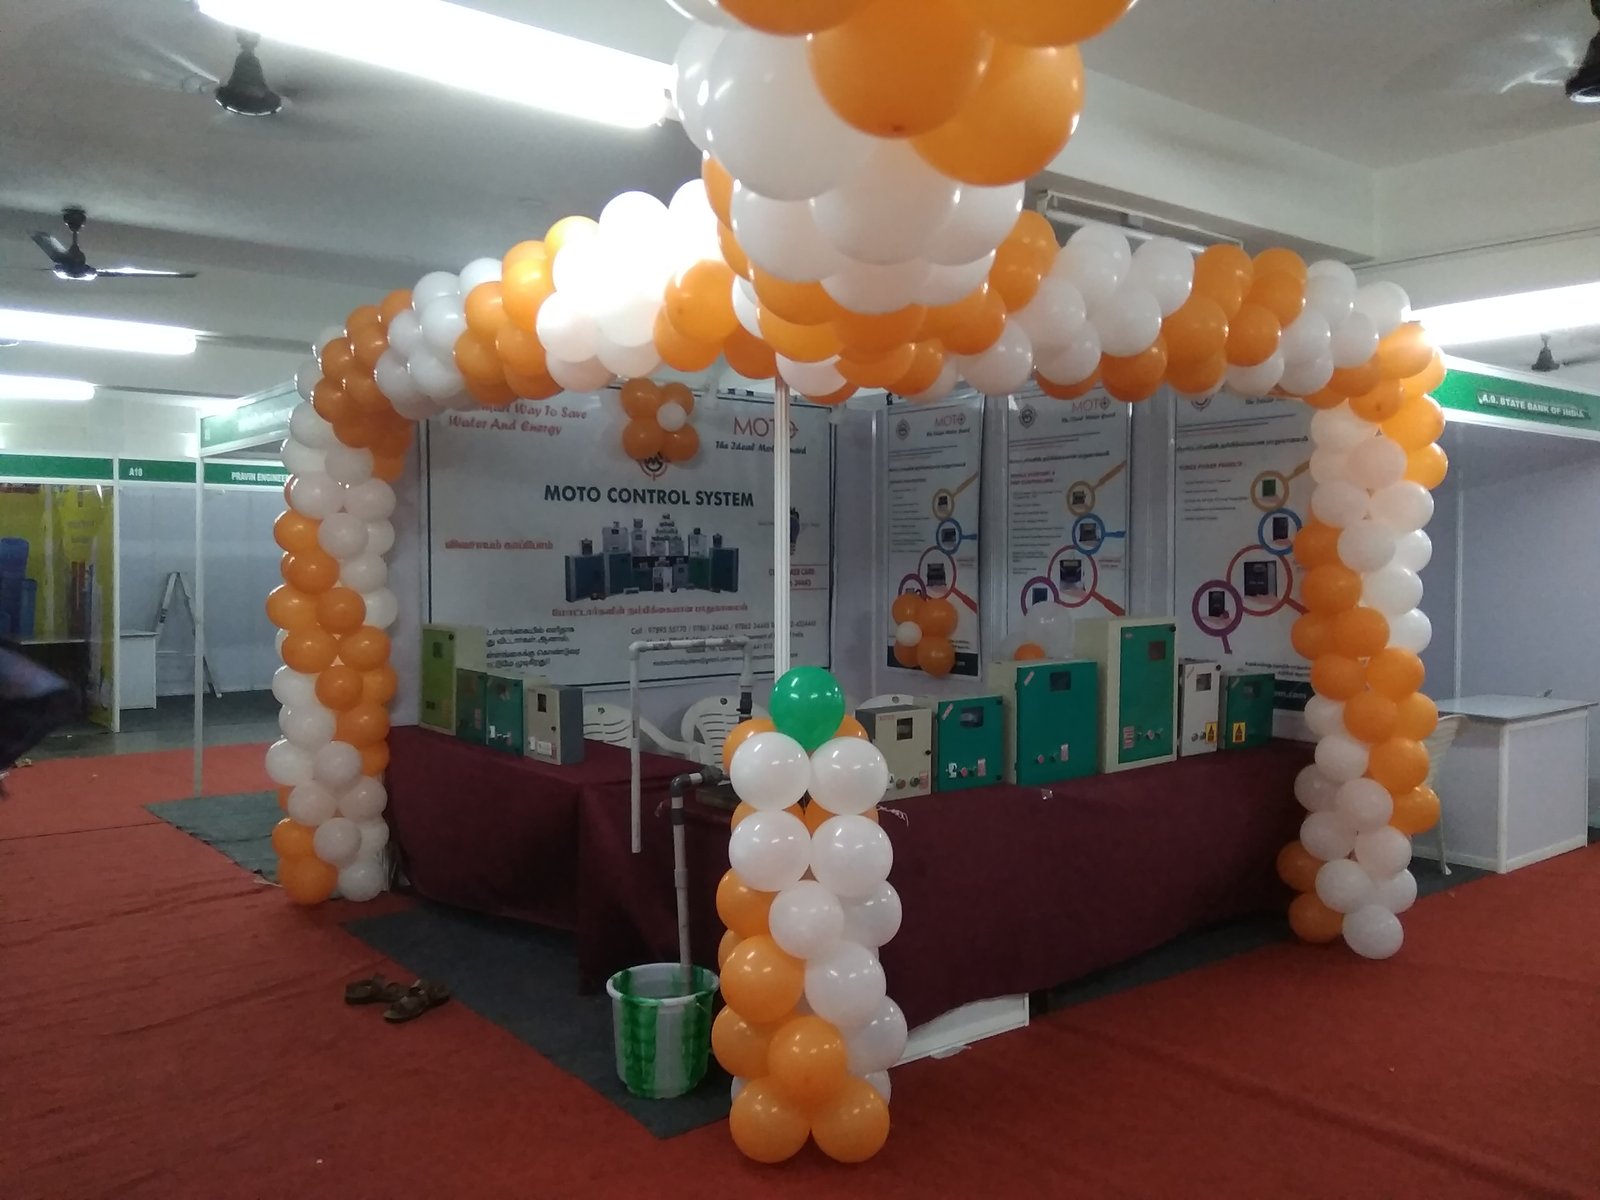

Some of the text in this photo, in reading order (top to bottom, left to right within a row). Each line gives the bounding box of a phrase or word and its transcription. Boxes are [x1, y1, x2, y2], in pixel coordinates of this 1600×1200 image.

[515, 404, 542, 418] Way
[545, 405, 557, 417] To
[561, 407, 588, 420] Save
[1500, 397, 1525, 409] STATE
[1527, 402, 1549, 413] BANK
[1551, 406, 1560, 415] OF
[448, 417, 562, 436] Water And Energy
[715, 440, 730, 450] The
[544, 485, 754, 507] MOTO CONTROL SYSTEM
